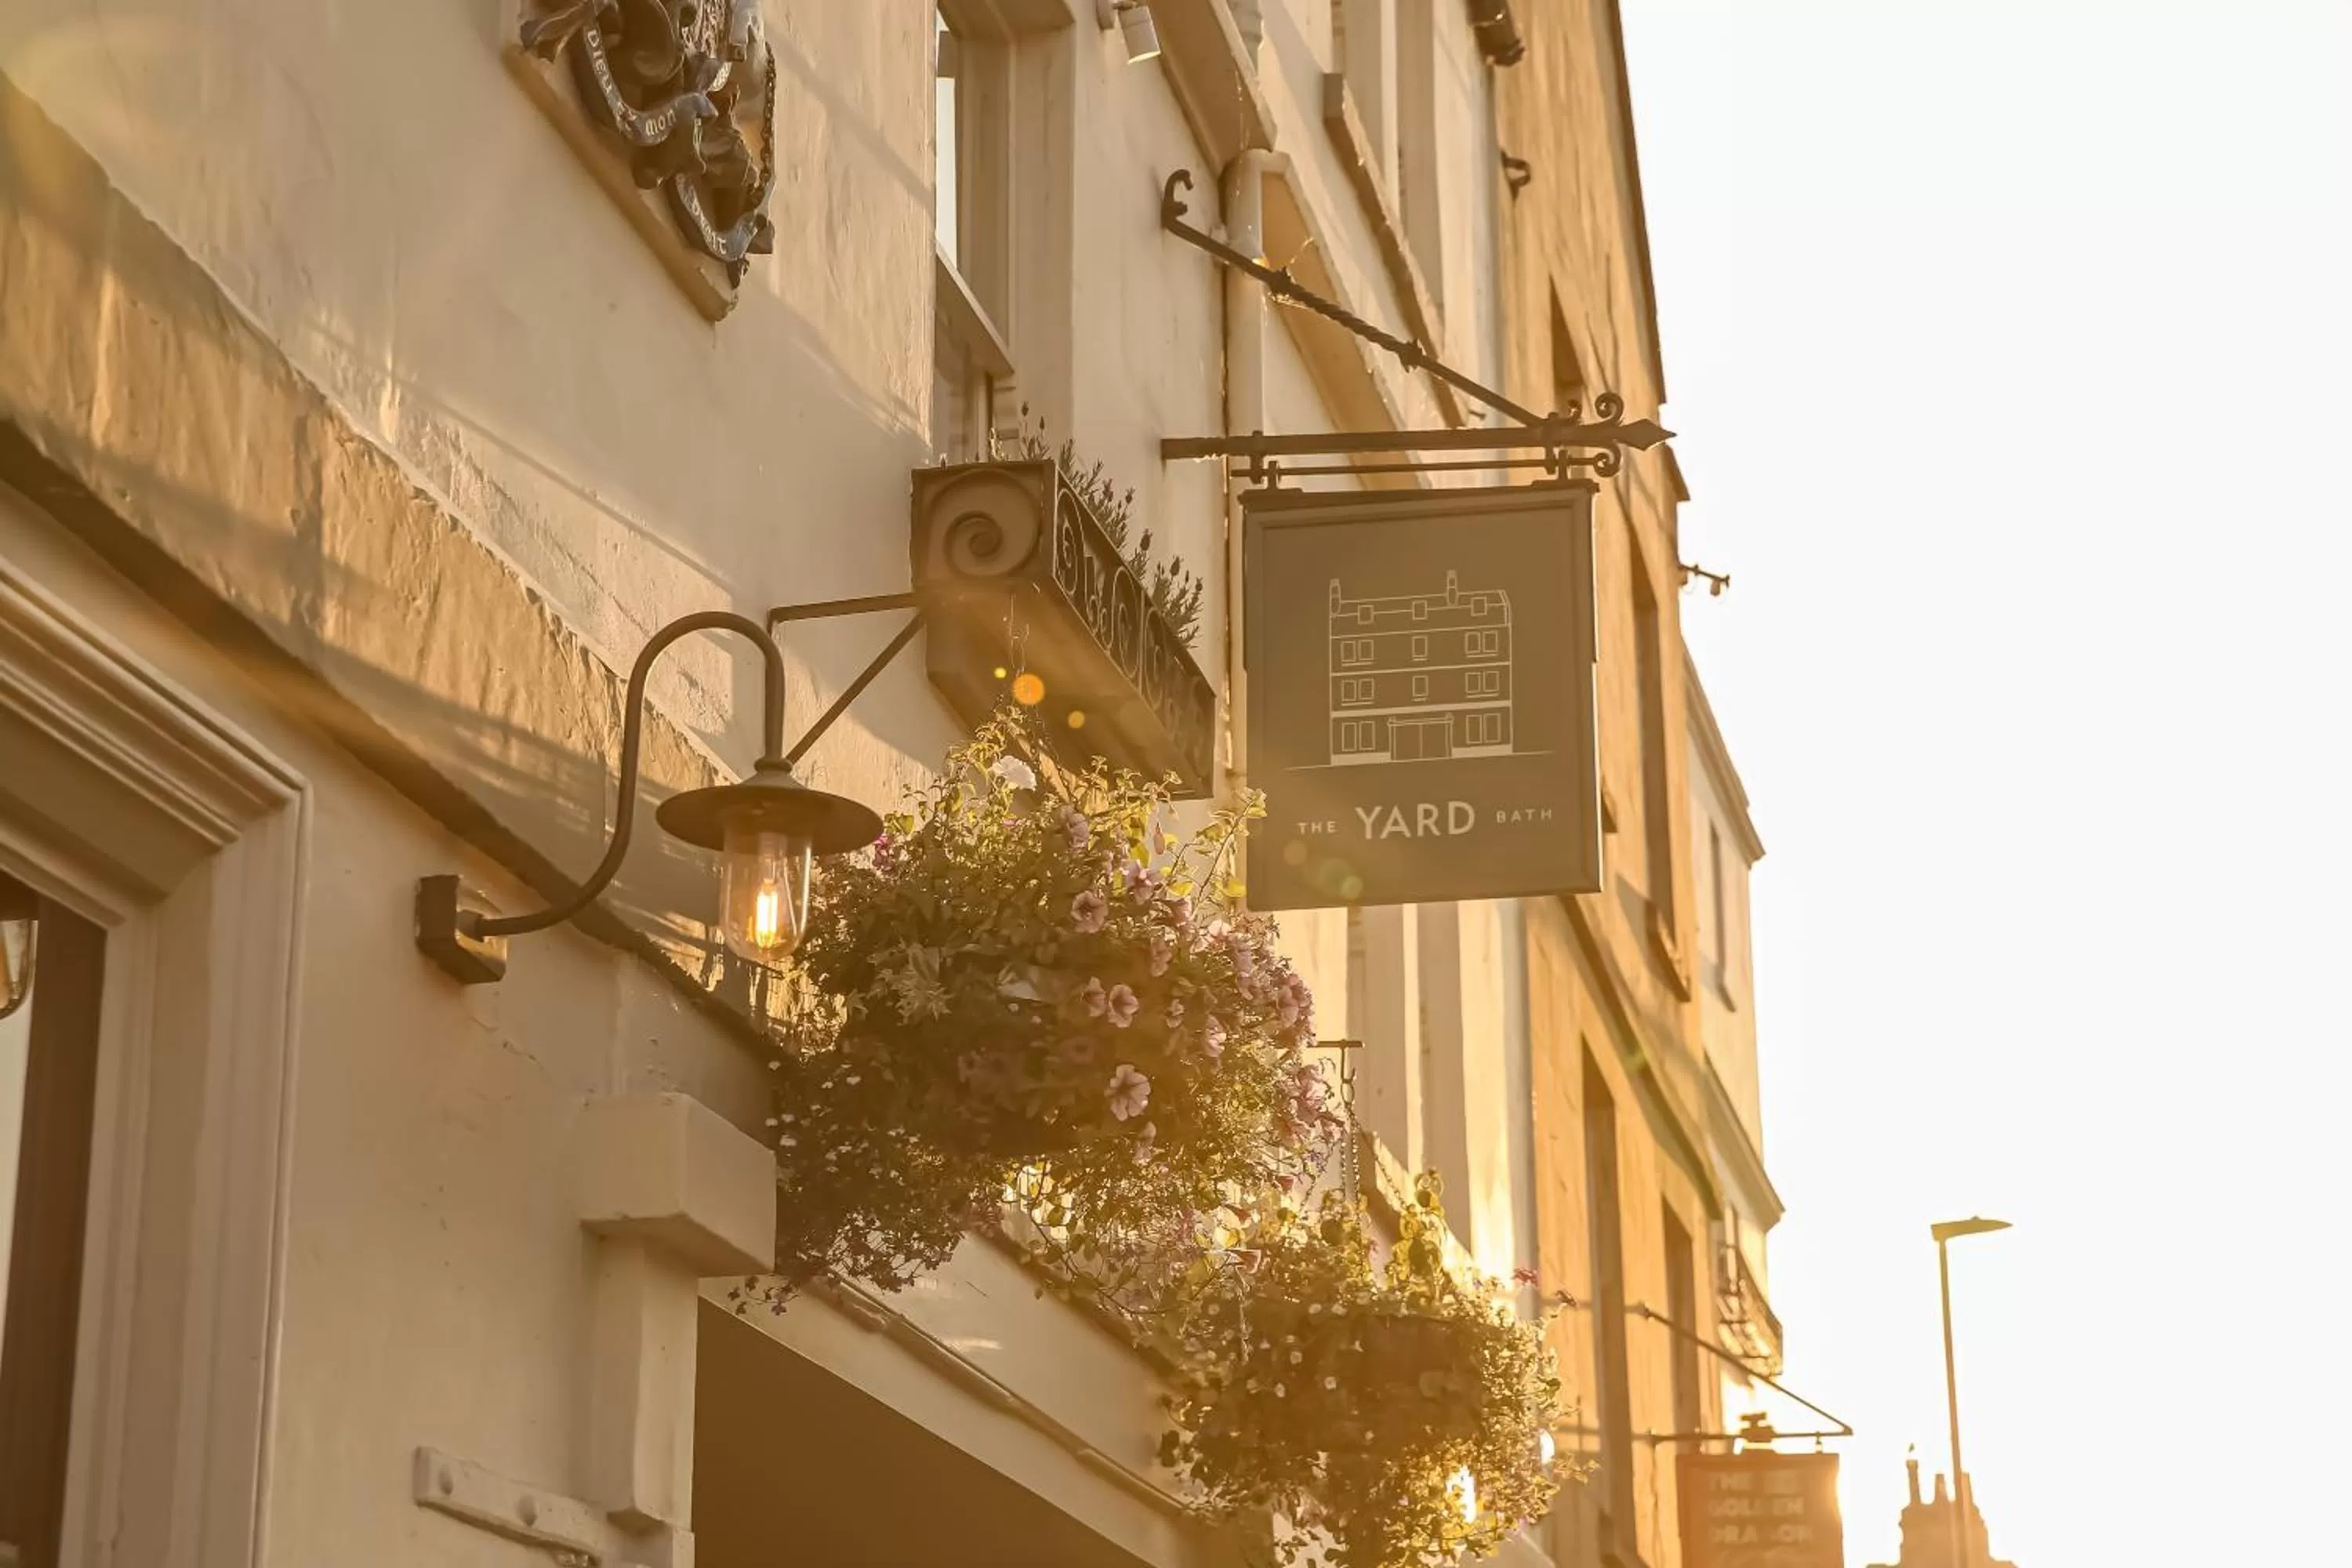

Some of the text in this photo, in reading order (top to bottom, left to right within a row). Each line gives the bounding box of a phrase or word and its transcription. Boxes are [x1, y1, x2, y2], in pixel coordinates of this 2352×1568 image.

[1298, 801, 1553, 840] THE YARD BATH
